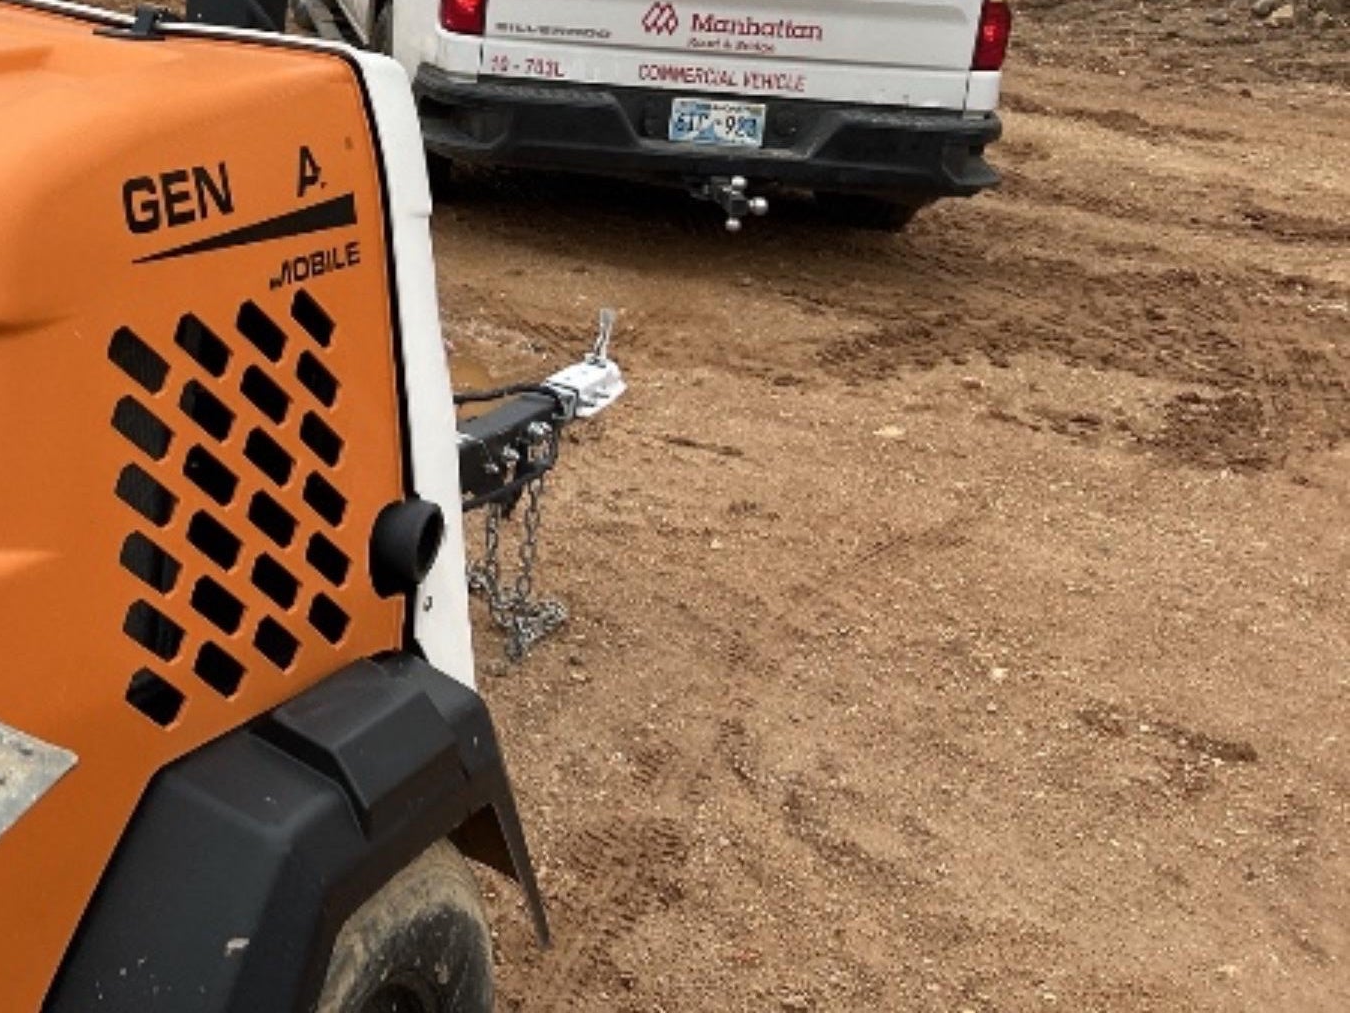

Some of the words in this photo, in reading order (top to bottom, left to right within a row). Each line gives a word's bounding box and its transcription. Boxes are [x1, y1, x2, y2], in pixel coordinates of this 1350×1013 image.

[691, 13, 823, 40] Manhattan
[638, 63, 739, 87] COMMERCIAL
[742, 71, 806, 93] VEHICLE
